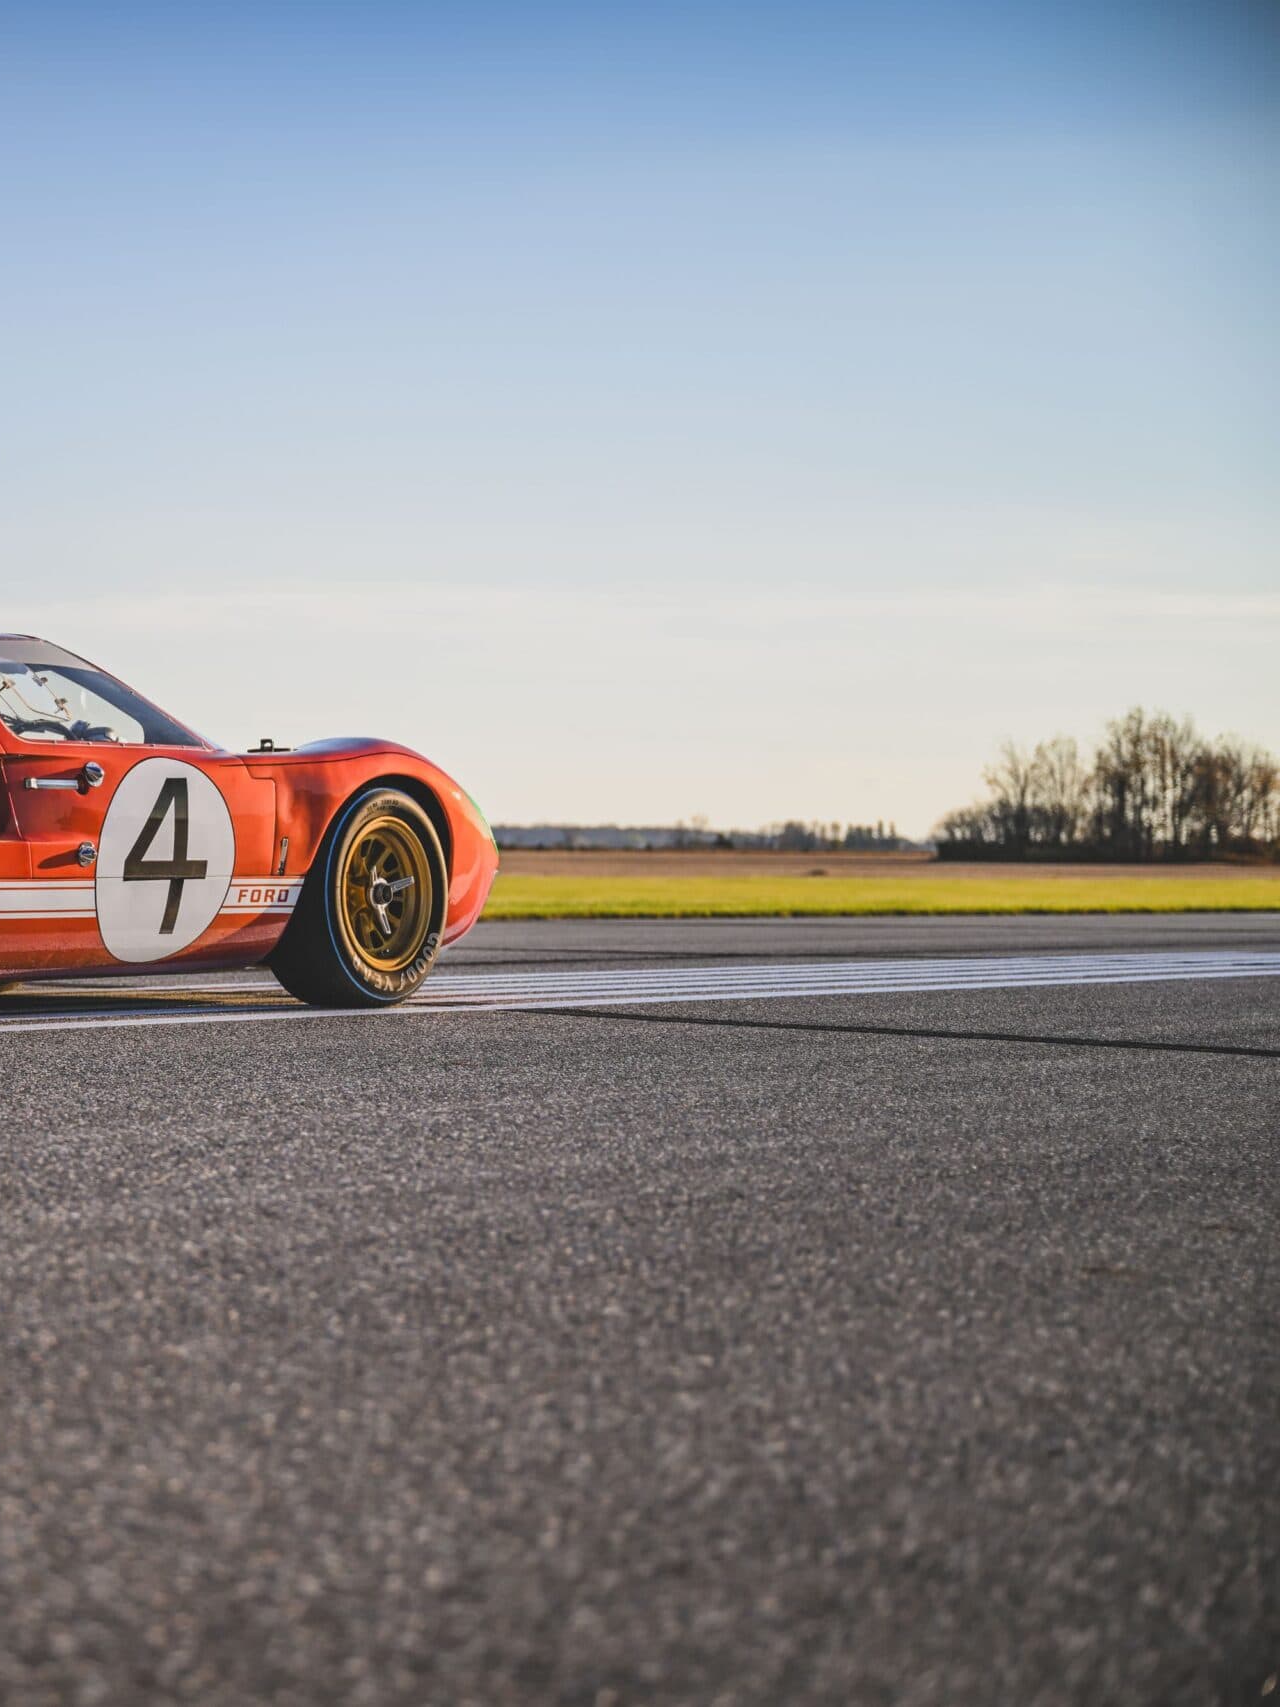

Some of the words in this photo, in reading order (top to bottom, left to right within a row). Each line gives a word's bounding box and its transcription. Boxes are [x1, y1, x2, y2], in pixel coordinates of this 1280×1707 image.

[123, 777, 208, 934] 4
[238, 889, 289, 903] FORD
[353, 932, 440, 992] GOODYEAR
